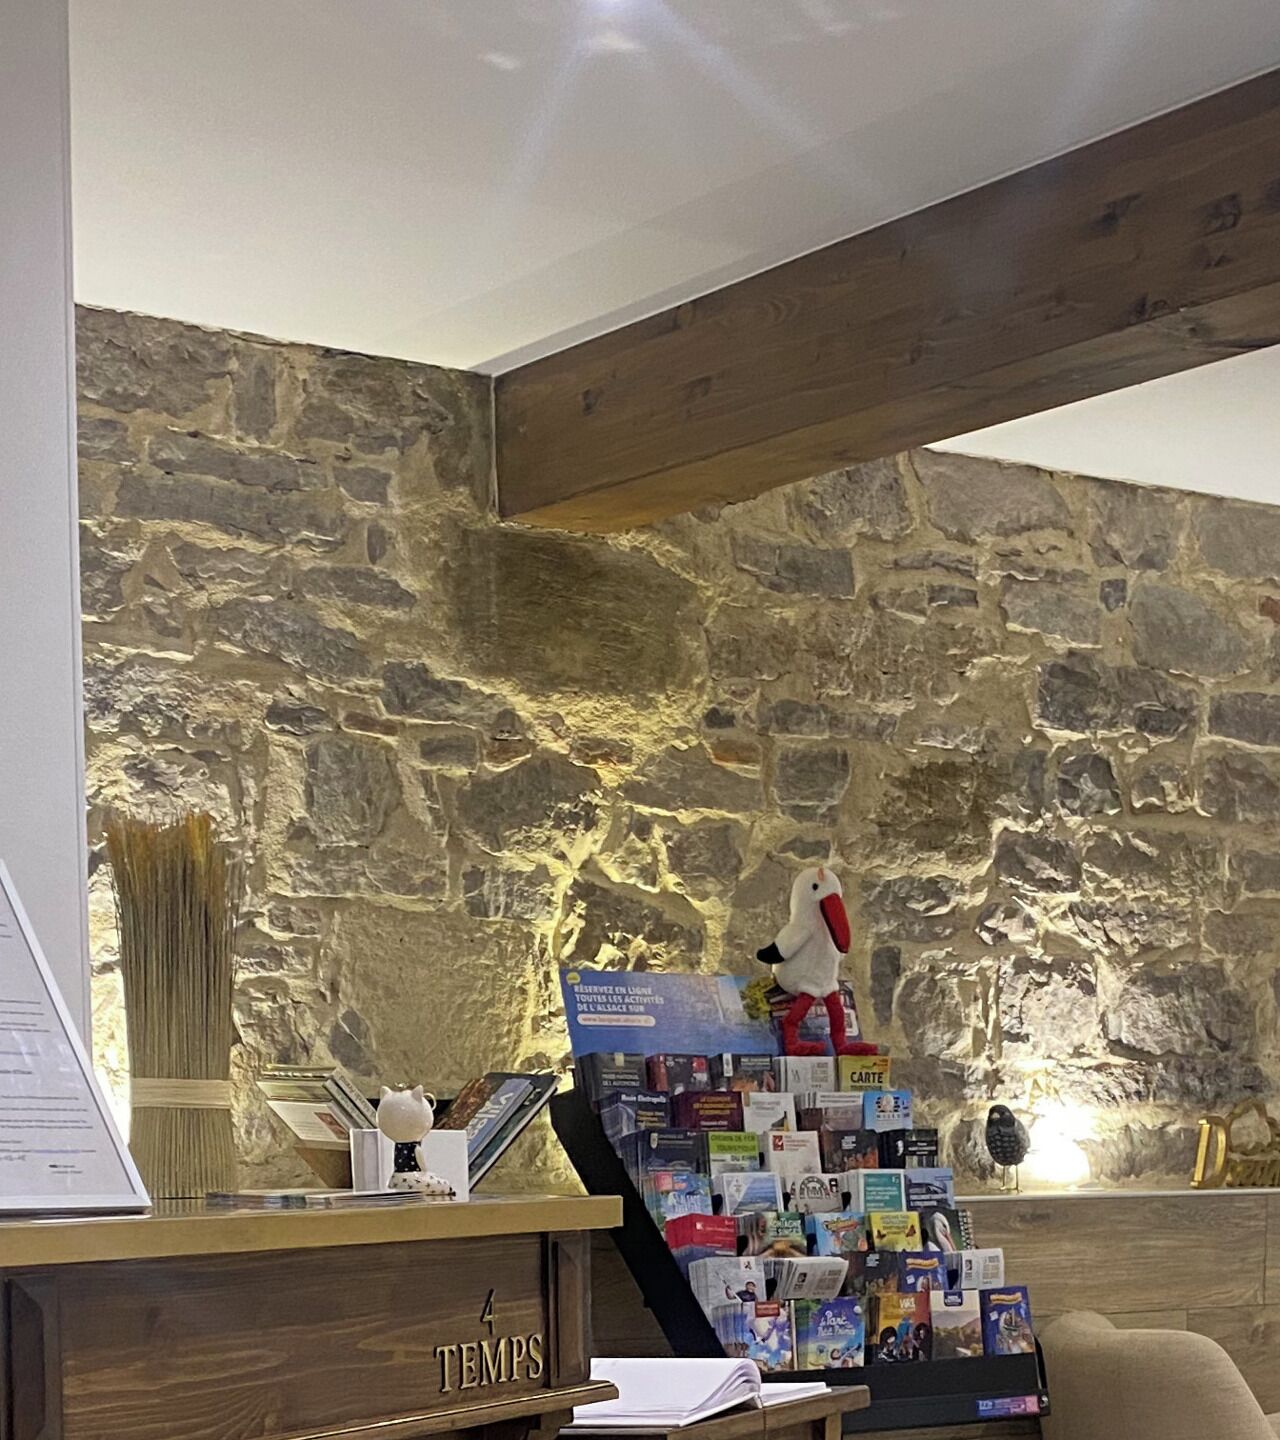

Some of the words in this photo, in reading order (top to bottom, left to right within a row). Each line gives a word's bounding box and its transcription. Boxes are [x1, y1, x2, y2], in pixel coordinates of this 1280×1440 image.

[574, 985, 613, 994] RÉSERVEZ
[615, 985, 626, 994] EN
[627, 986, 652, 995] LIGNE
[575, 994, 607, 1003] TOUTES
[608, 995, 622, 1003] LES
[624, 995, 664, 1004] ACTIVITÉS
[577, 1004, 588, 1012] DE
[590, 1004, 627, 1012] L'ALSACE
[629, 1004, 645, 1013] SUR
[850, 1071, 884, 1084] CARTE
[480, 1288, 498, 1336] 4
[434, 1333, 543, 1393] TEMPS
